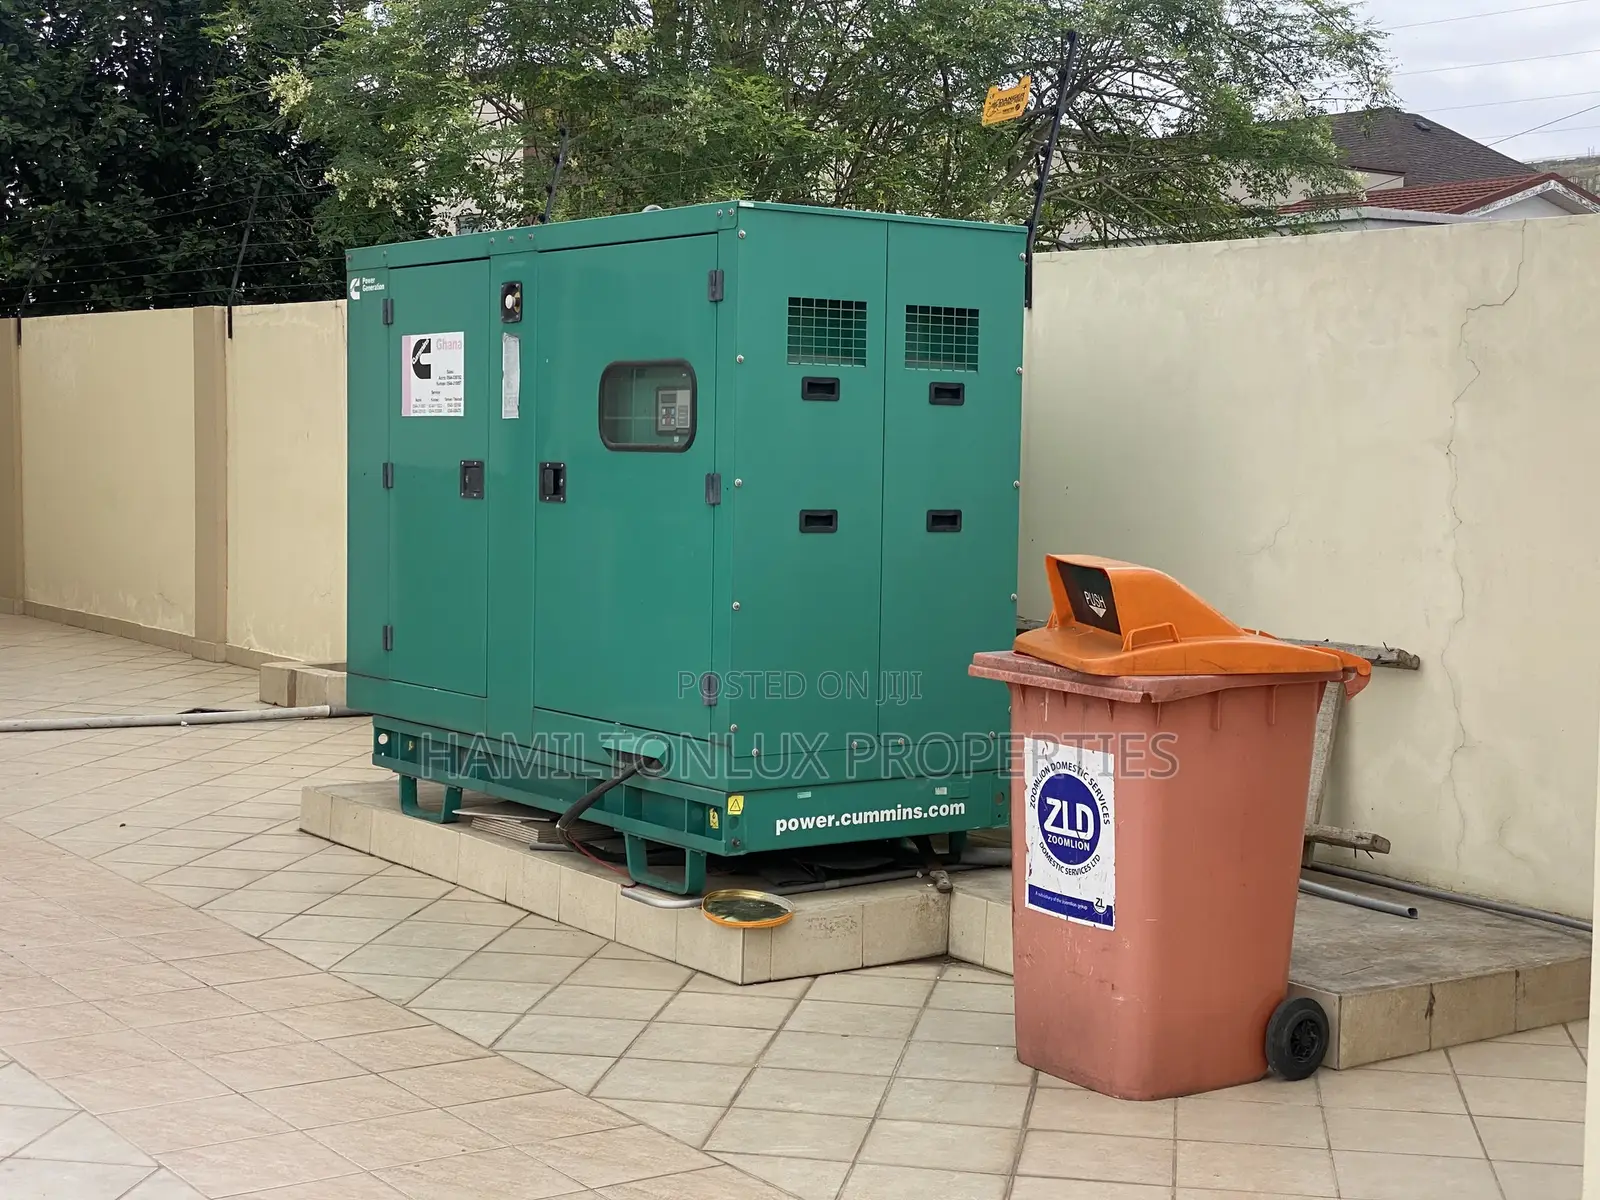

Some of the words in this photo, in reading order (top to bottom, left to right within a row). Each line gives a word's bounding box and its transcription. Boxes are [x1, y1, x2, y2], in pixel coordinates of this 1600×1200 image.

[436, 337, 463, 350] Ghana
[1083, 590, 1107, 609] PUSH
[1030, 766, 1051, 809] ZOOMLION
[1050, 761, 1089, 781] DOMESTIC
[1088, 778, 1110, 825] SERVICES
[775, 802, 965, 836] power.cummins.com
[1043, 796, 1095, 841] ZLD
[1039, 841, 1065, 874] DOMESTIC
[1065, 863, 1092, 876] SERVICES
[1091, 854, 1101, 868] LTD
[1047, 833, 1090, 852] ZOOMLION
